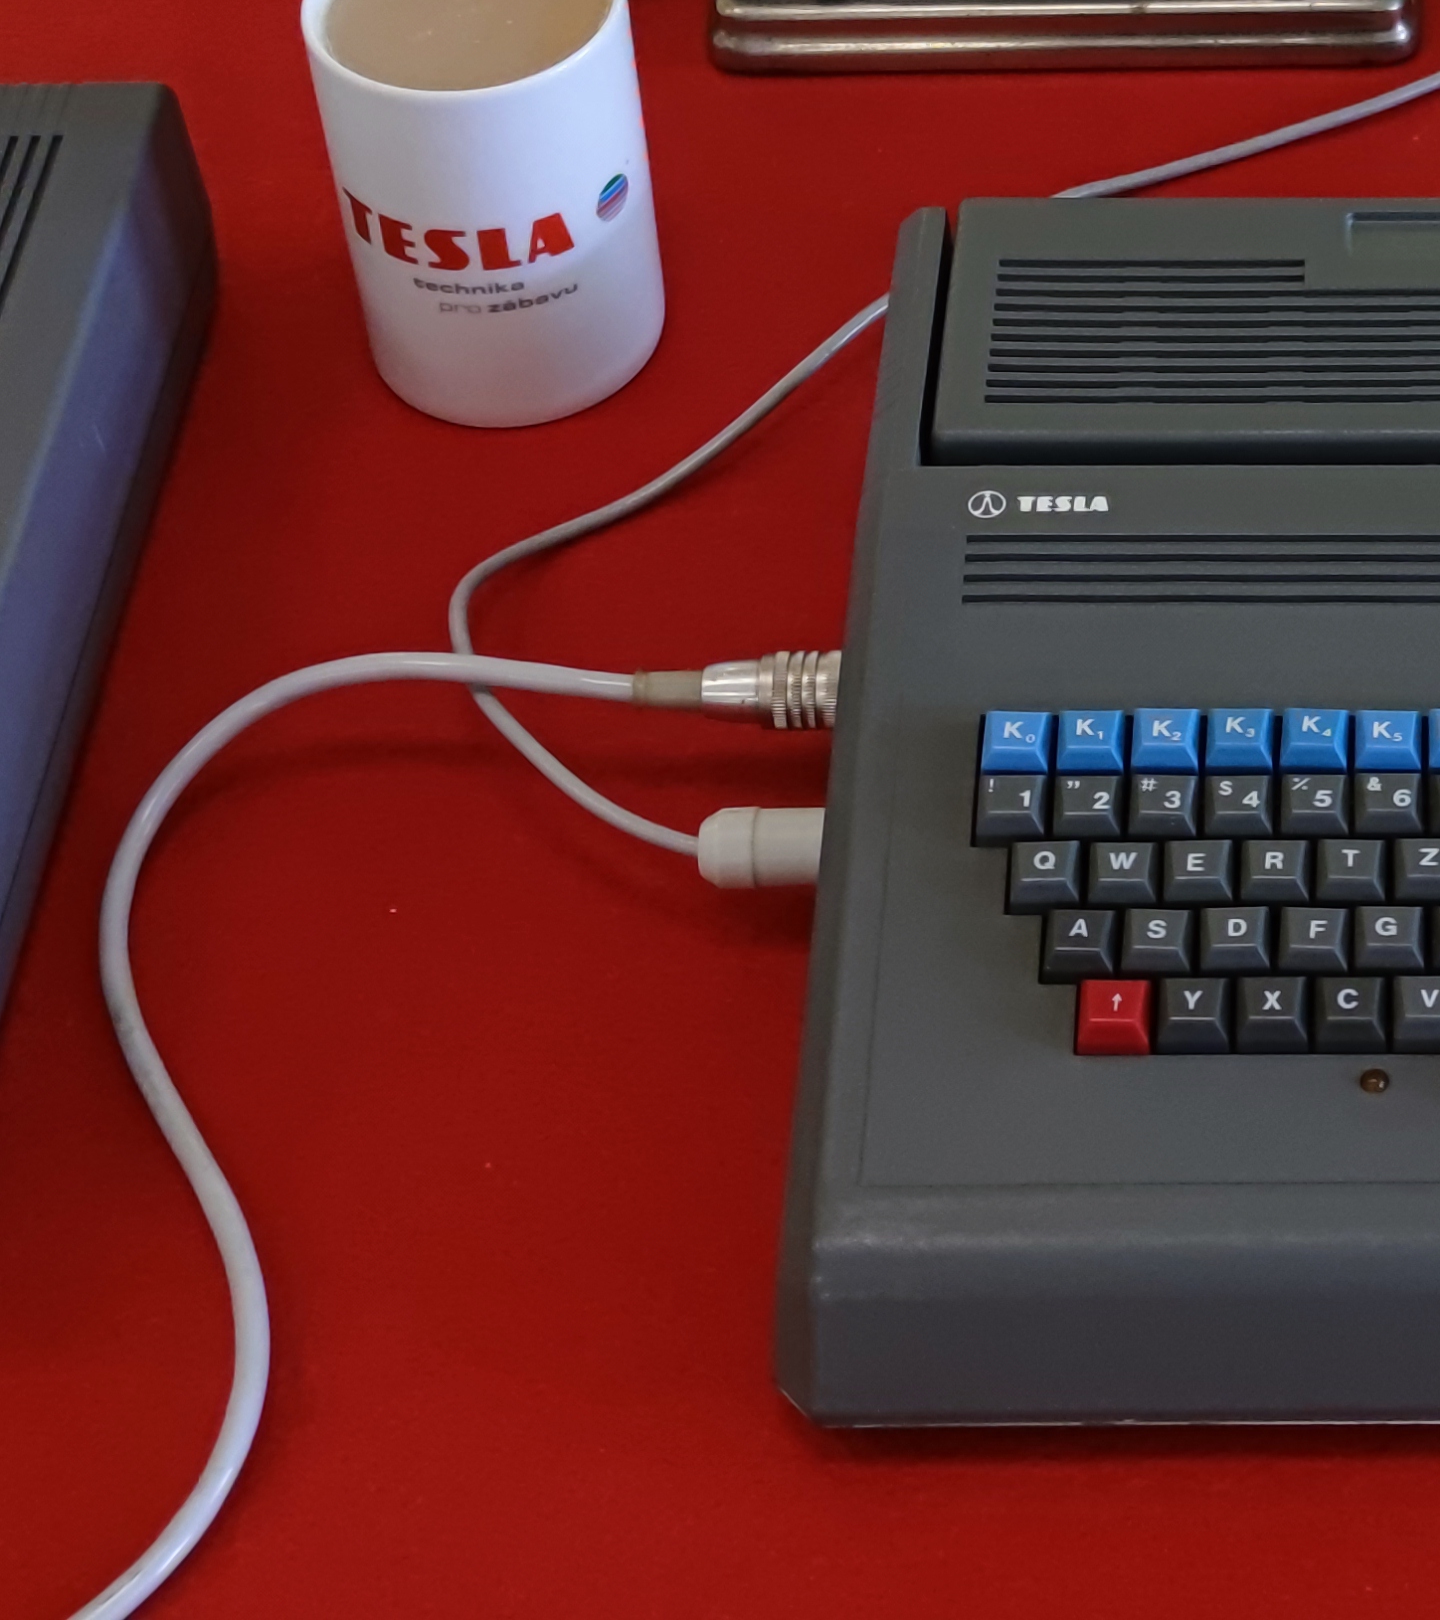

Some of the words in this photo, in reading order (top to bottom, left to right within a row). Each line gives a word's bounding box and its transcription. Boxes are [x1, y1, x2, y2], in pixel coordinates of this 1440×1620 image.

[342, 187, 574, 271] TESLA
[413, 278, 524, 294] technika
[440, 302, 481, 313] pro
[1017, 496, 1108, 511] TESLA
[1019, 790, 1030, 807] 1
[1092, 792, 1110, 809] 2
[1163, 791, 1181, 809] 3
[1242, 791, 1260, 807] 4
[1313, 790, 1332, 808] 5
[1393, 789, 1411, 807] 6
[1034, 851, 1055, 869] Q
[1110, 852, 1137, 869] W
[1187, 853, 1205, 871] E
[1265, 852, 1283, 869] R
[1342, 849, 1359, 866] T
[1419, 848, 1439, 865] Z
[1069, 919, 1088, 937] A
[1147, 920, 1166, 938] S
[1228, 919, 1247, 936] D
[1310, 920, 1327, 938] F
[1375, 917, 1397, 936] G
[1184, 991, 1202, 1009] Y
[1263, 991, 1281, 1010] X
[1337, 989, 1358, 1009] C
[1421, 990, 1439, 1007] V
